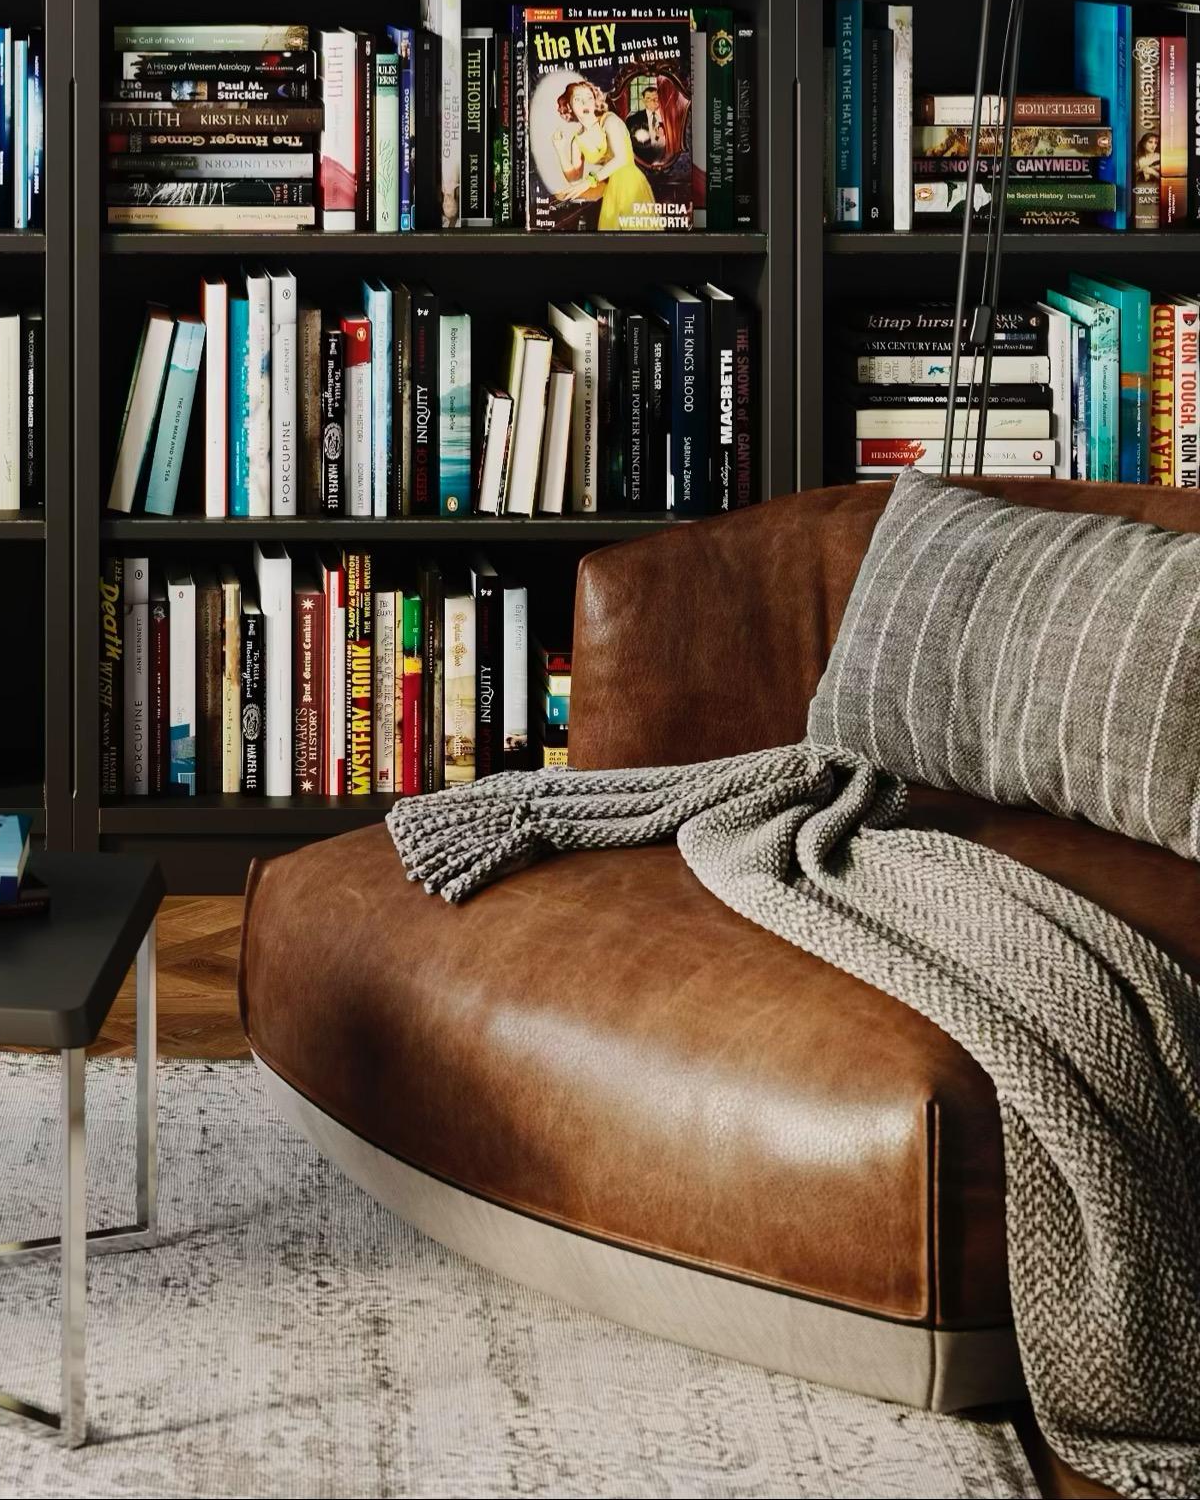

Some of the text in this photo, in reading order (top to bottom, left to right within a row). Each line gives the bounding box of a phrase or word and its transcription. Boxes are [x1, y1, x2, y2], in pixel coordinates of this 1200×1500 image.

[569, 9, 583, 17] She
[613, 9, 626, 17] Too
[632, 9, 653, 17] Much
[657, 9, 666, 17] To
[671, 9, 688, 17] Live
[534, 24, 616, 61] the KEY
[538, 49, 681, 74] door to murder and violence
[622, 35, 678, 51] unlocks the
[154, 63, 177, 73] History
[187, 63, 216, 71] Western
[218, 63, 251, 73] Astrology
[218, 81, 263, 90] Paul M.
[843, 15, 851, 124] THE CAT IN THE HAT
[218, 91, 268, 100] Strickler
[467, 50, 480, 133] THE HOBBIT
[1018, 104, 1095, 115] BEETLEJUICE
[150, 134, 302, 147] The Hunger Games
[200, 114, 288, 125] KIRSTEN KELLY
[709, 98, 721, 191] Title of your cover
[914, 159, 1089, 172] THE GANYMEDE
[470, 155, 478, 209] J.R.R. TOLKIEN
[619, 216, 689, 228] WENTWORTH
[633, 204, 687, 214] PATRICIA
[684, 314, 694, 412] THE KING'S BLOOD
[1153, 305, 1173, 382] HARD
[323, 361, 334, 417] Mockingbird
[335, 369, 341, 381] To
[721, 350, 732, 444] MACBETH
[417, 385, 430, 443] INIQUITY
[737, 327, 750, 507] THE SNOWS of GANYMEDE
[1152, 390, 1172, 421] IT
[1178, 332, 1196, 463] RUN TOUGH, RUN
[632, 368, 640, 500] THE PORTER PRINCIPLES
[282, 421, 291, 503] PORCUPINE
[328, 464, 339, 508] HARPER LEE
[683, 470, 691, 500] ZBASNIK
[100, 579, 122, 660] Death
[100, 662, 112, 708] WISH
[481, 665, 494, 722] INIQUITY
[134, 700, 143, 782] PORCUPINE
[296, 708, 307, 776] HOGWARTS
[247, 744, 257, 788] HARPER LEE
[310, 767, 317, 775] A
